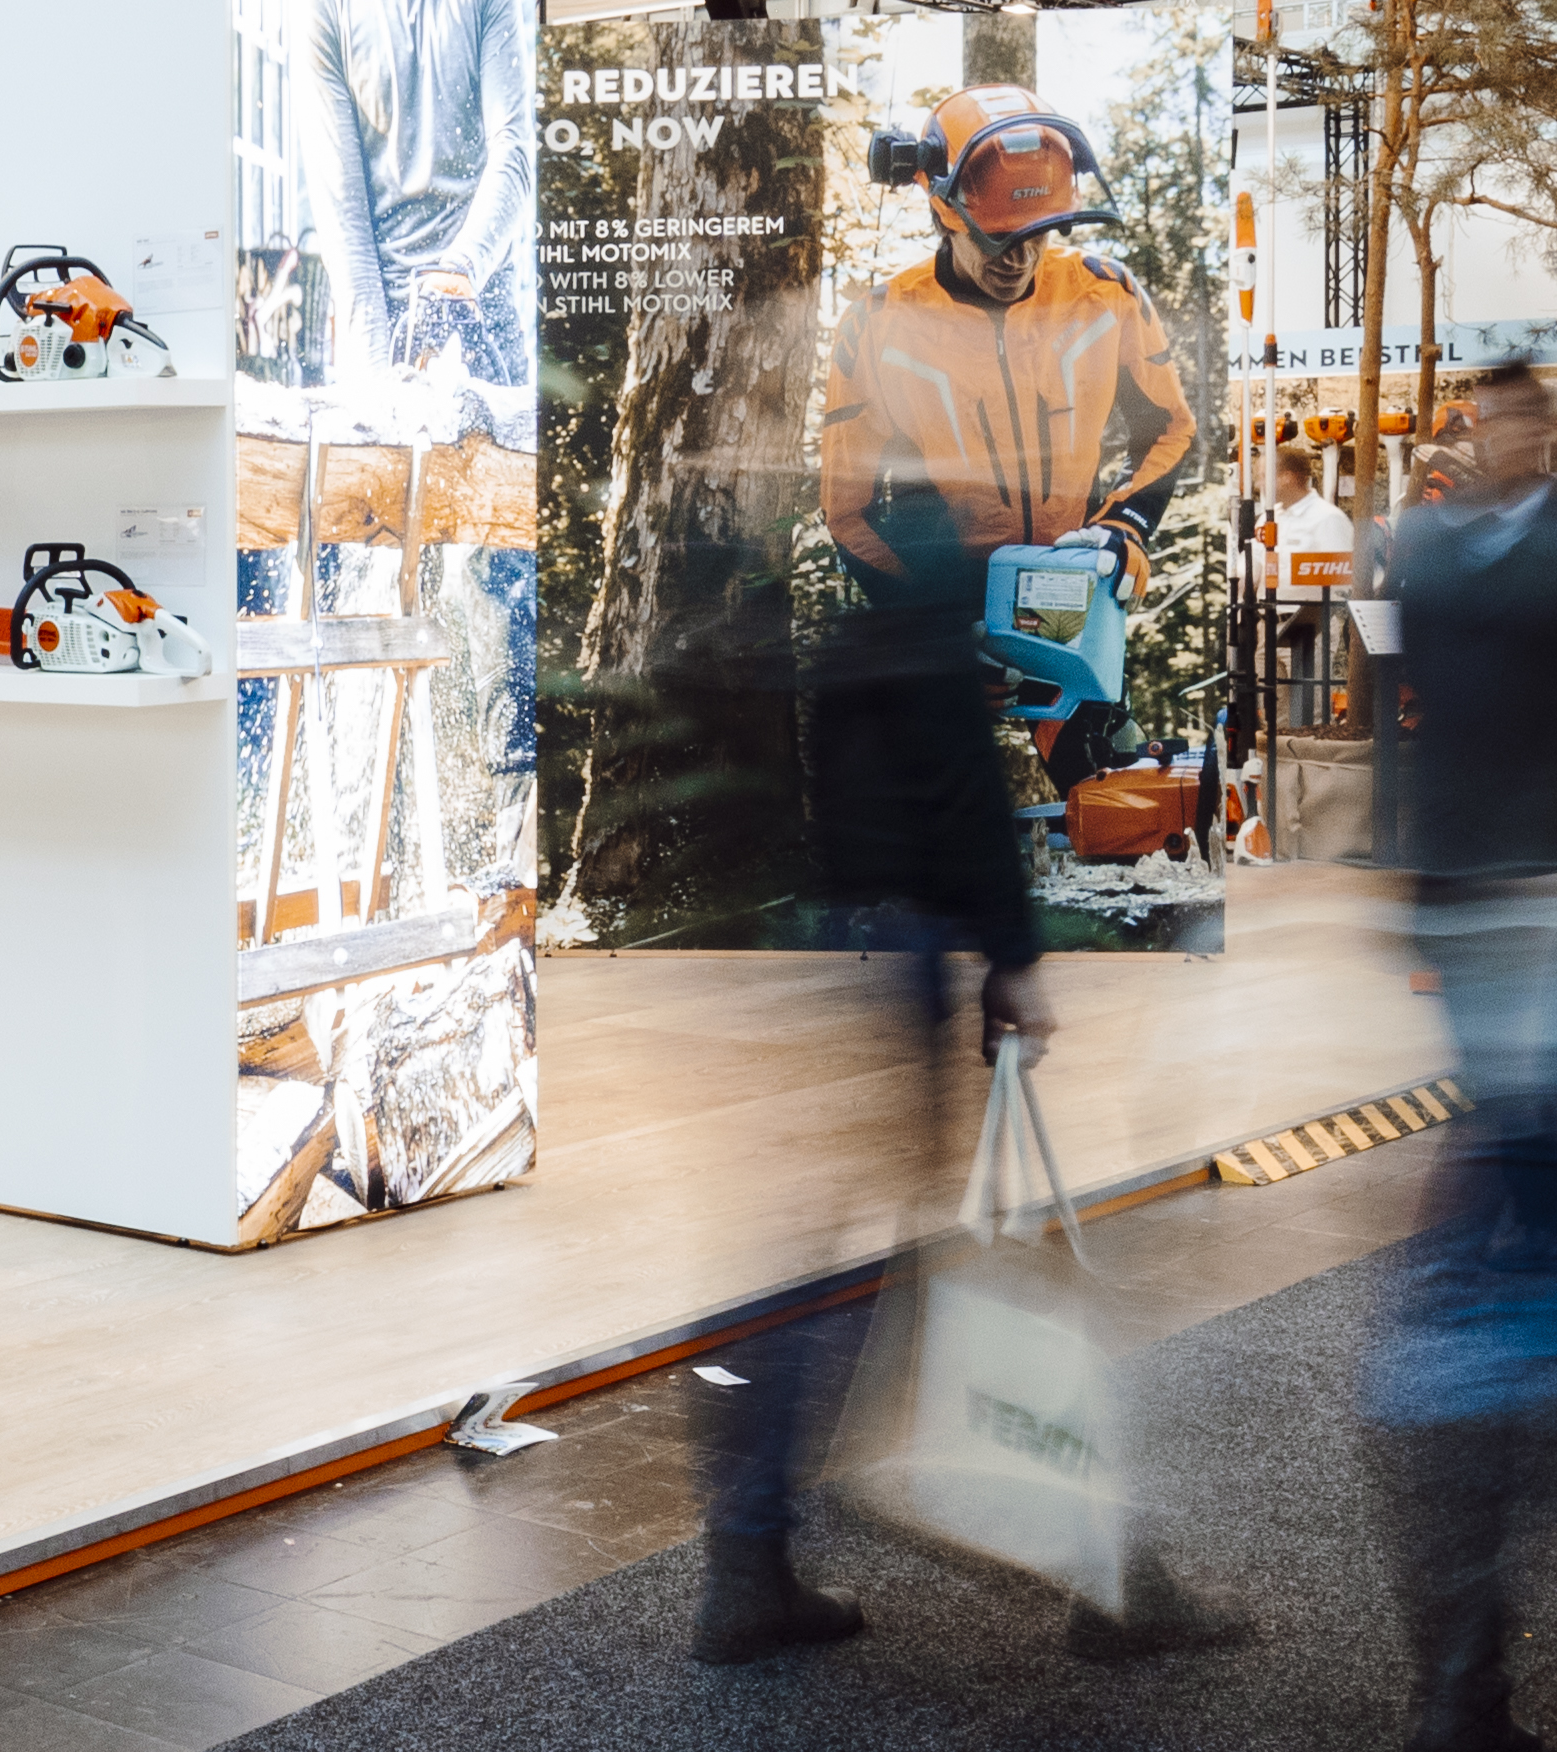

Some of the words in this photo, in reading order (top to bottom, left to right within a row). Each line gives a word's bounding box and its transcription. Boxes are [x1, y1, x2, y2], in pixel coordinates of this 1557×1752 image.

[563, 63, 858, 104] REDUZIEREN
[612, 115, 725, 152] NOW
[1012, 185, 1051, 200] STIHL
[550, 220, 589, 239] MIT
[634, 216, 785, 238] GERINGEREM
[582, 243, 692, 263] MOTOMIX
[549, 271, 608, 290] WITH
[655, 269, 735, 288] LOWER
[555, 296, 616, 314] STIHL
[623, 294, 734, 313] MOTOMIX
[1298, 562, 1353, 576] STIHL
